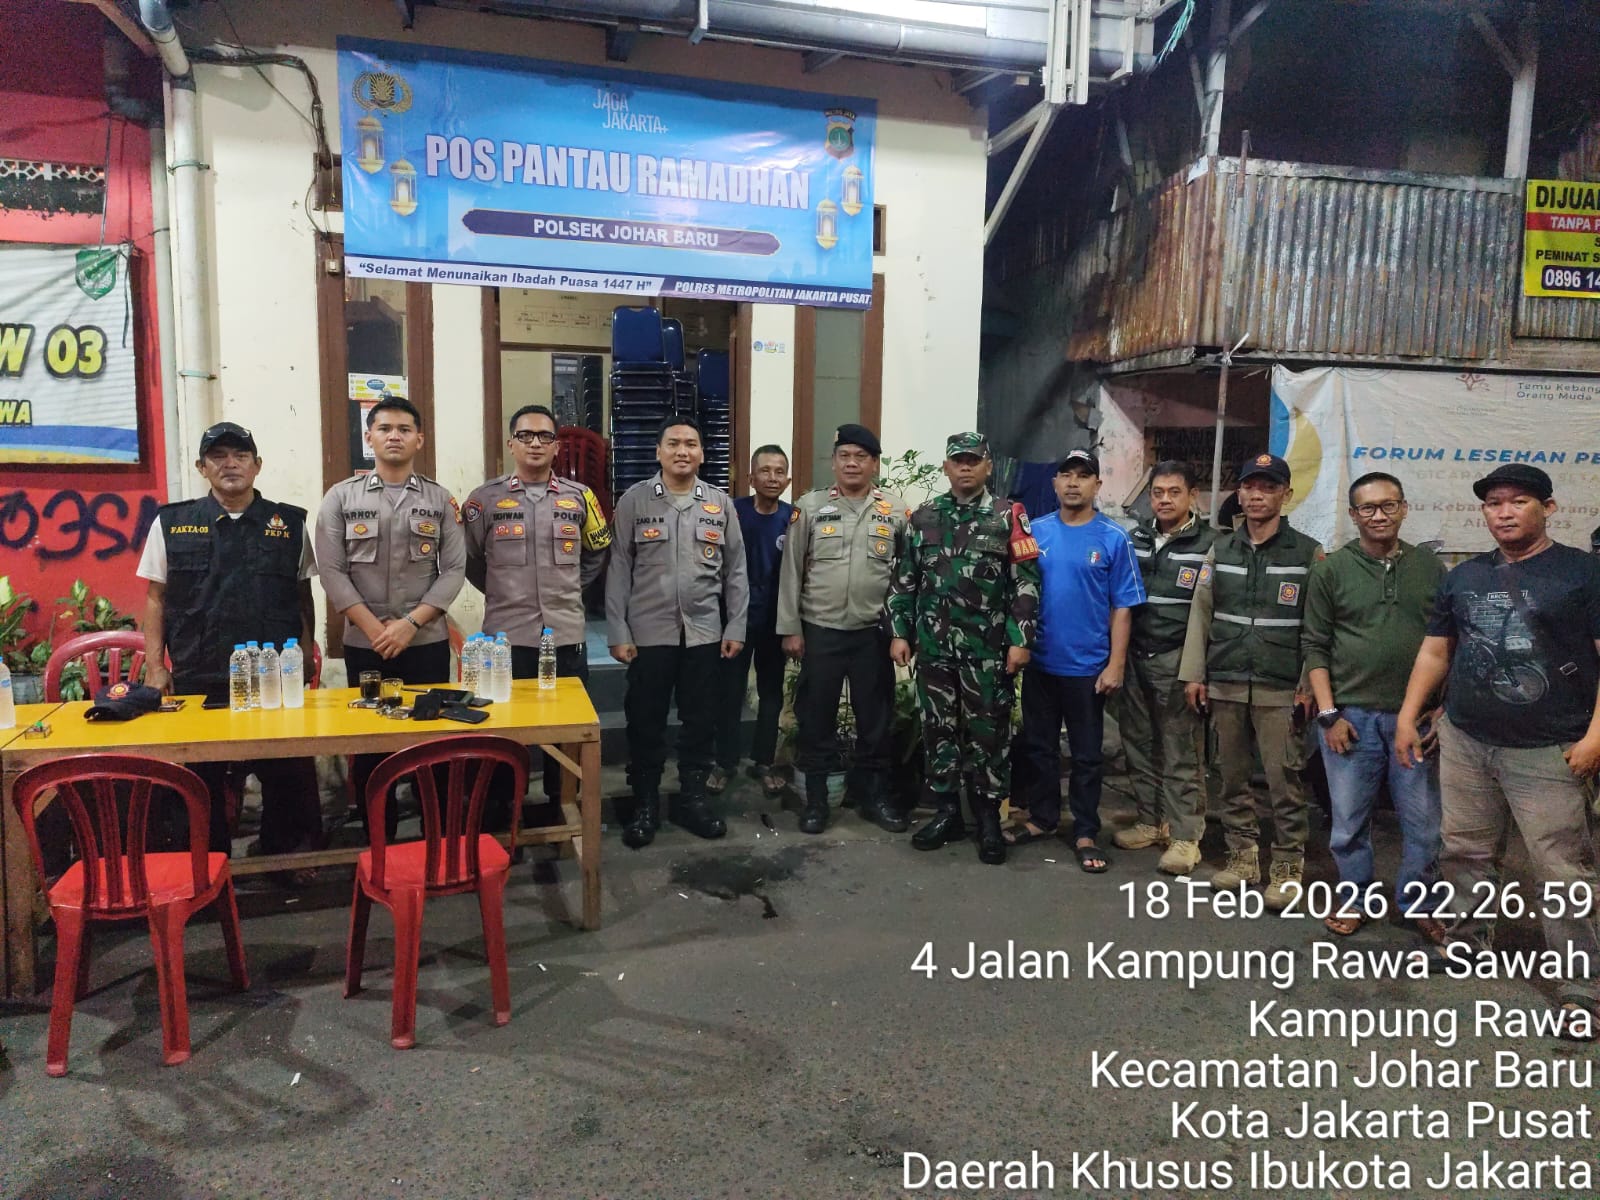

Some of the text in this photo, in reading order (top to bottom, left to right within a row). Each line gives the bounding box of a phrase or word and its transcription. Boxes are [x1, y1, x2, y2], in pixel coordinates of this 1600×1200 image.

[593, 88, 629, 112] JAGA
[425, 134, 809, 210] POS PANTAU RAMADHAN
[1550, 216, 1592, 231] TANPA
[533, 218, 719, 247] POLSEK JOHAR BARU
[1535, 249, 1589, 262] PEMINAT
[426, 267, 508, 282] Menunaikan
[512, 272, 556, 285] Ibadah
[560, 275, 598, 288] Puasa
[603, 278, 633, 290] 1447
[1545, 268, 1581, 288] 0896
[674, 281, 872, 305] POLRES METROPOLITAN JAKARTA PUSAT
[44, 323, 108, 379] 03
[1517, 382, 1551, 391] Temu
[1517, 391, 1592, 401] Orang Muda
[1352, 446, 1445, 461] FORUM
[1453, 448, 1566, 464] LESEHAN
[412, 508, 443, 519] POLRI
[553, 511, 583, 520] POLRI
[1560, 506, 1599, 517] rang
[699, 517, 723, 527] POLRI
